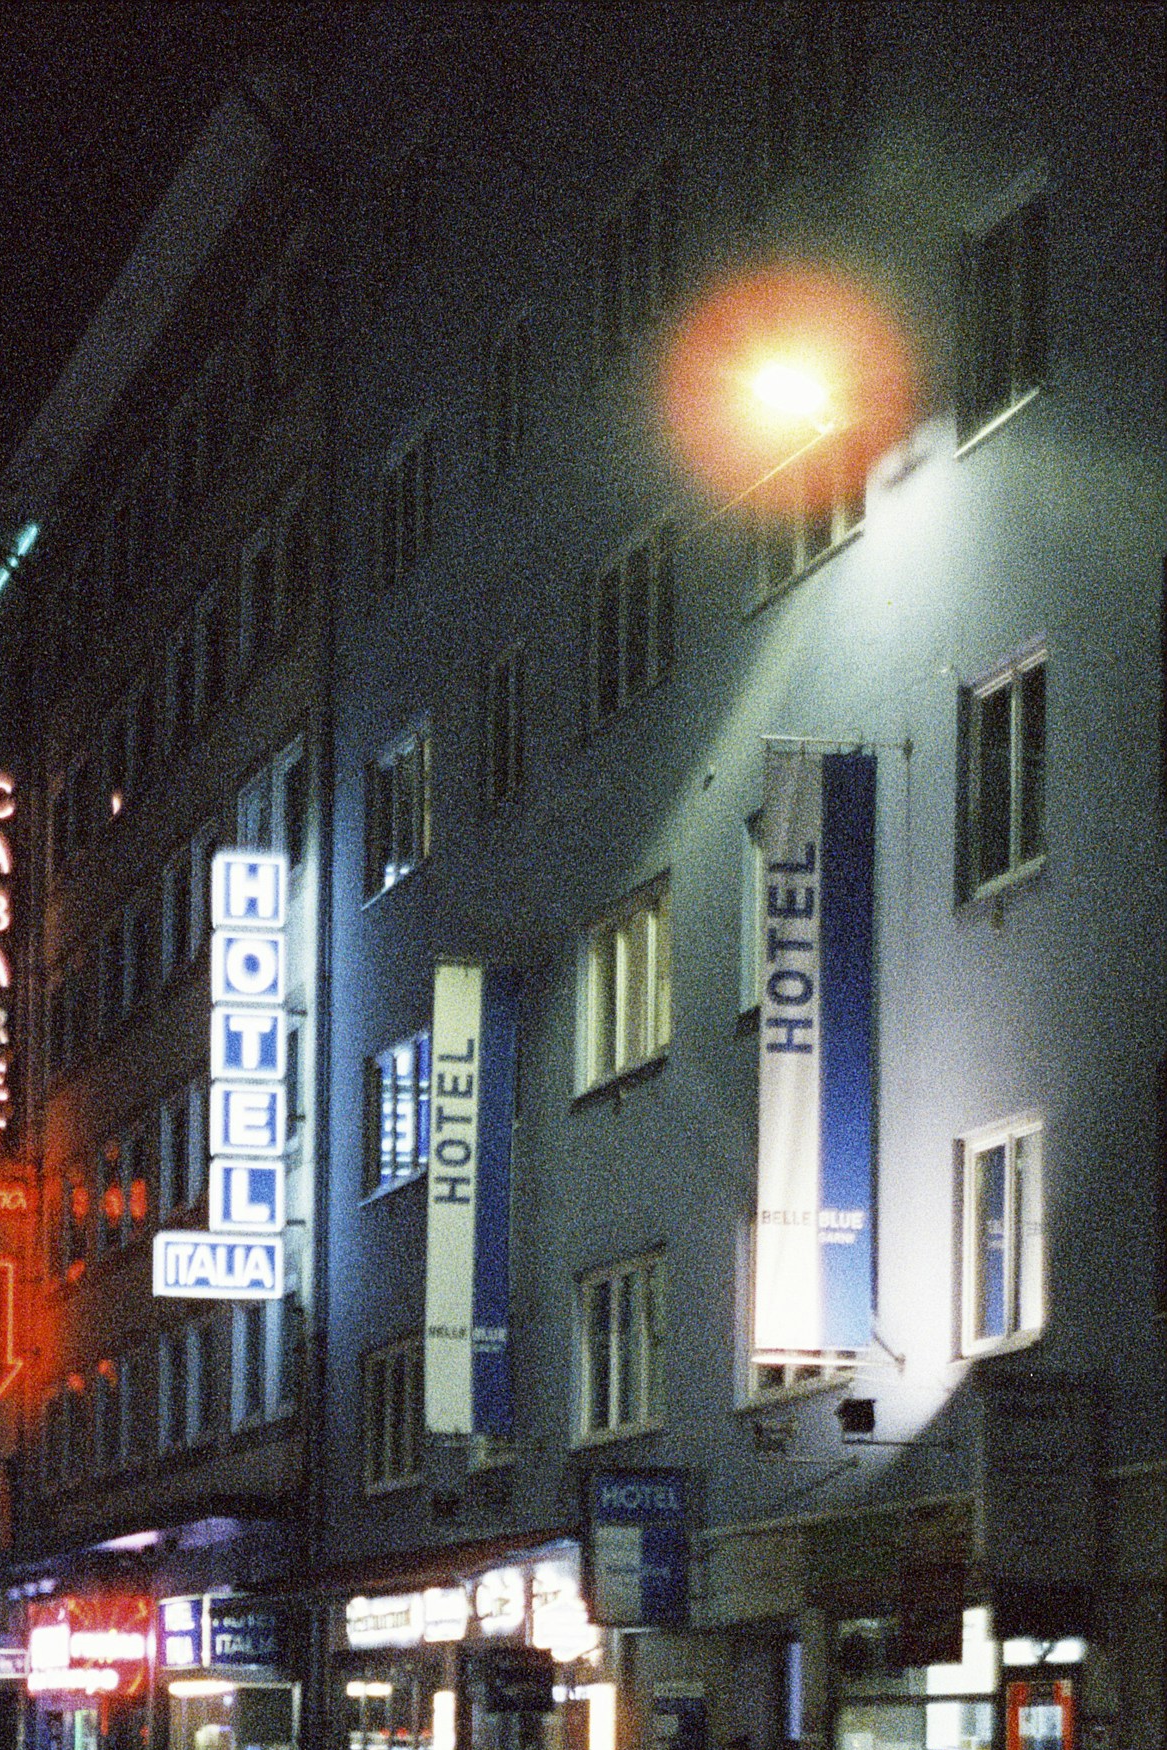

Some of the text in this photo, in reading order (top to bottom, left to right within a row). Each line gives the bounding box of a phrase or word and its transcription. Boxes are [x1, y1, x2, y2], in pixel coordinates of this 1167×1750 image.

[766, 840, 816, 1056] HOTEL
[226, 860, 276, 1221] HOTEL
[433, 1036, 476, 1206] HOTEL
[165, 1243, 273, 1289] ITALIA
[761, 1209, 864, 1230] BELLE BLUE
[600, 1483, 679, 1511] HOTEL
